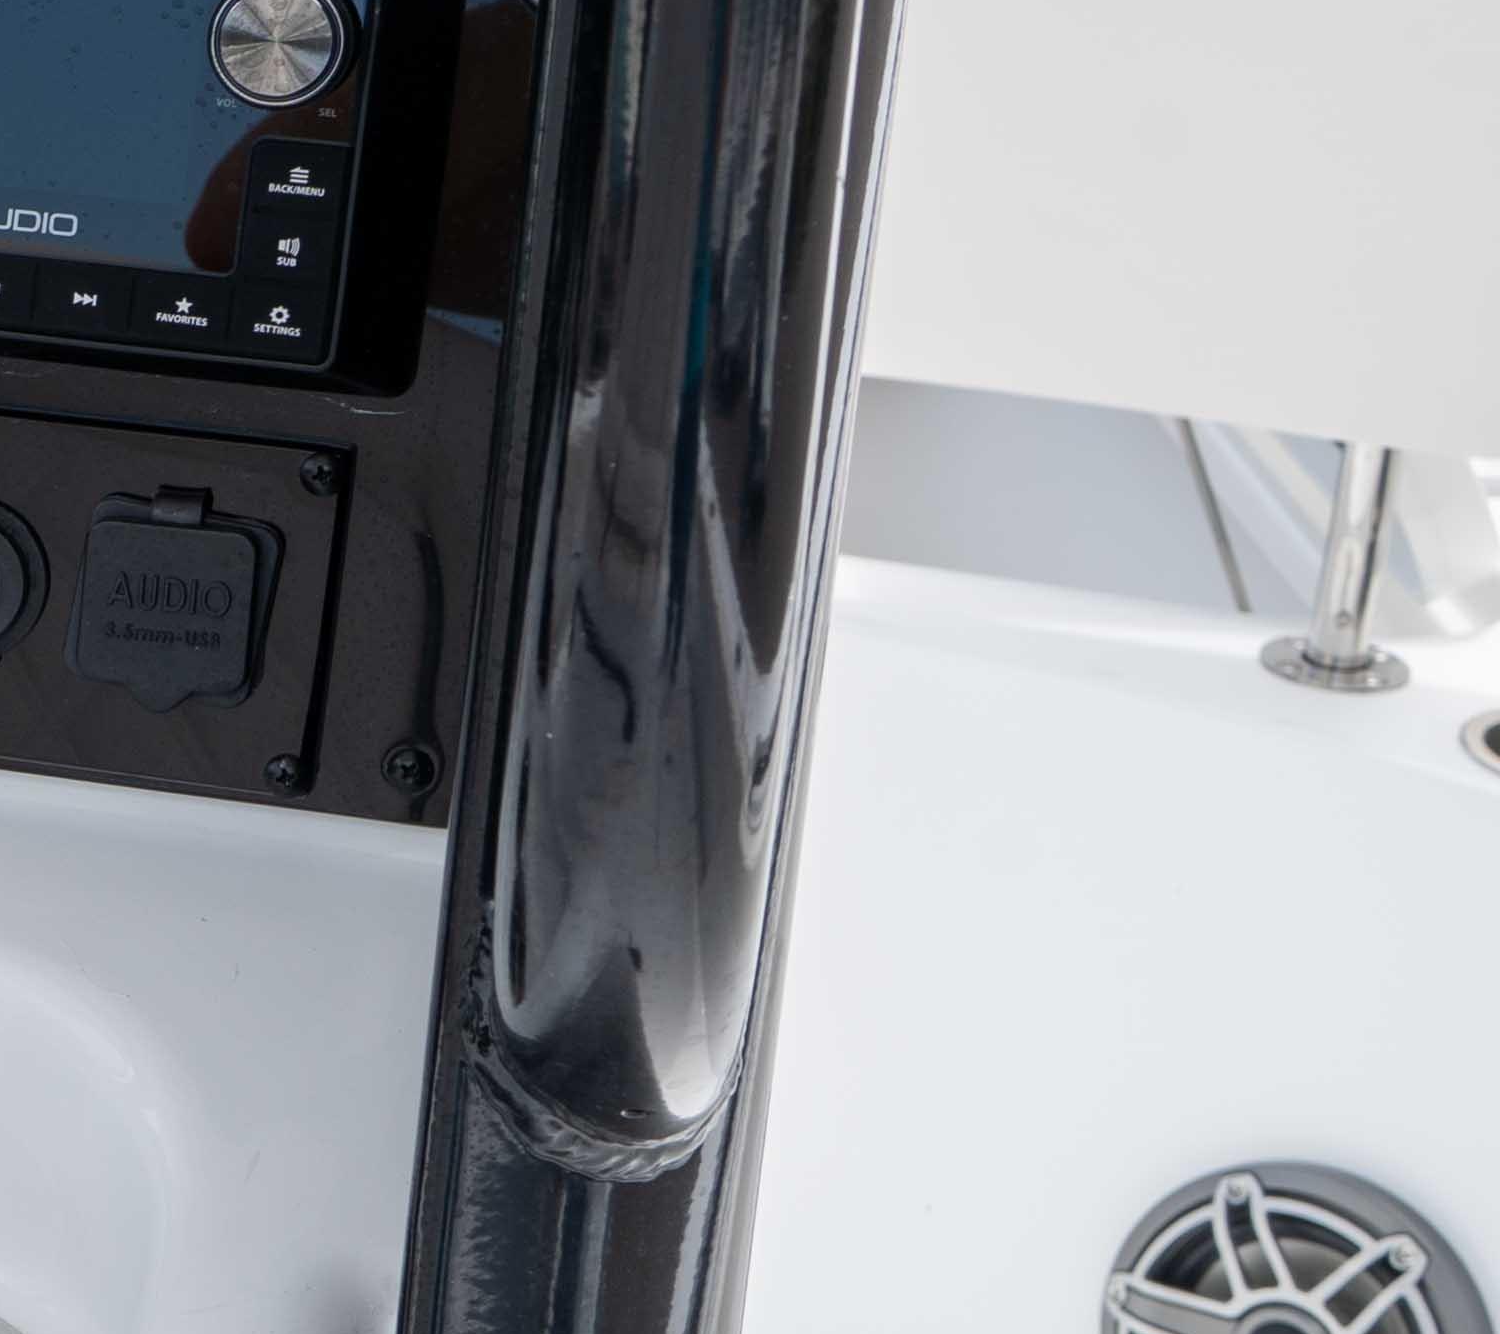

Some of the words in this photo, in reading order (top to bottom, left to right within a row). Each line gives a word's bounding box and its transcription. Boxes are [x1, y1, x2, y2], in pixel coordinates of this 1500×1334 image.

[318, 107, 337, 118] SEL
[268, 182, 325, 197] BACK/MENU
[276, 256, 297, 267] SUB
[155, 311, 208, 327] FAVORITES
[253, 322, 301, 337] SETTINGS
[108, 570, 233, 618] AUDIO
